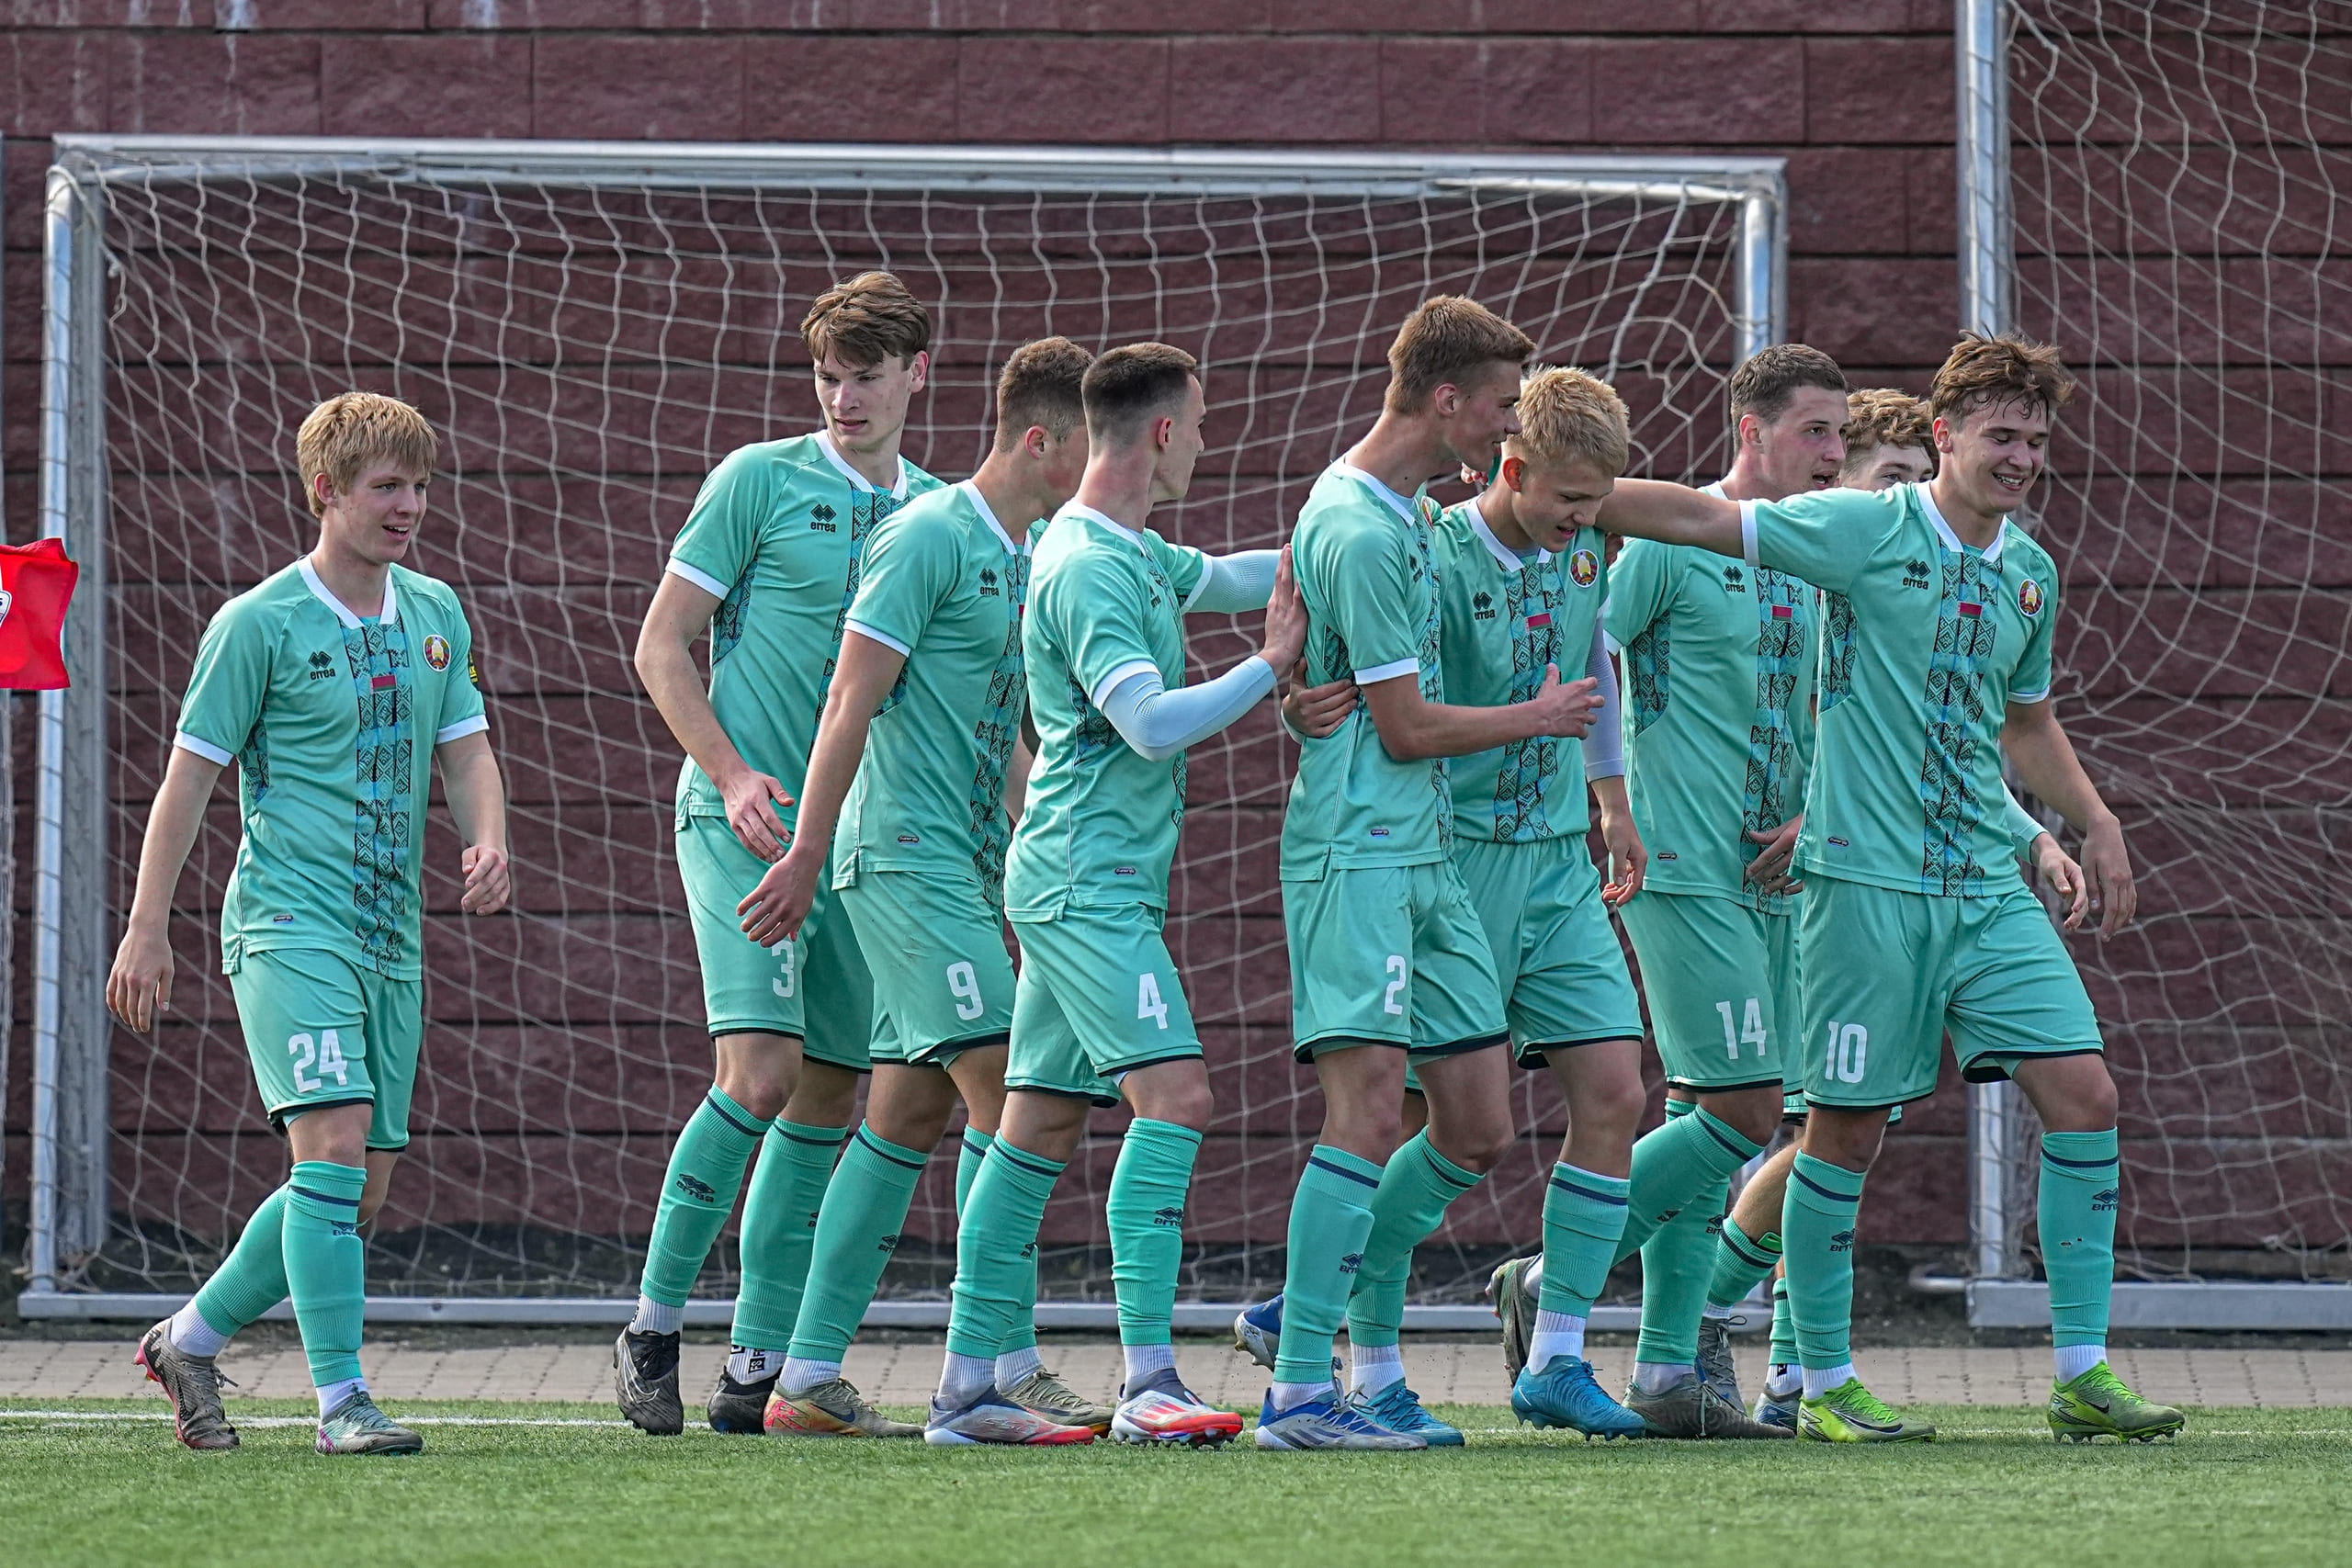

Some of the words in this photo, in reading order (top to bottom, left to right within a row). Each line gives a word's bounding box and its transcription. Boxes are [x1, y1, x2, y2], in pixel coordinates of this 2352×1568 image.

[772, 940, 795, 998] 3
[946, 961, 984, 1021] 9
[1384, 954, 1407, 1015] 2
[1137, 972, 1169, 1030] 4
[1715, 998, 1767, 1060] 14
[288, 1029, 347, 1093] 24
[1825, 1021, 1868, 1084] 10
